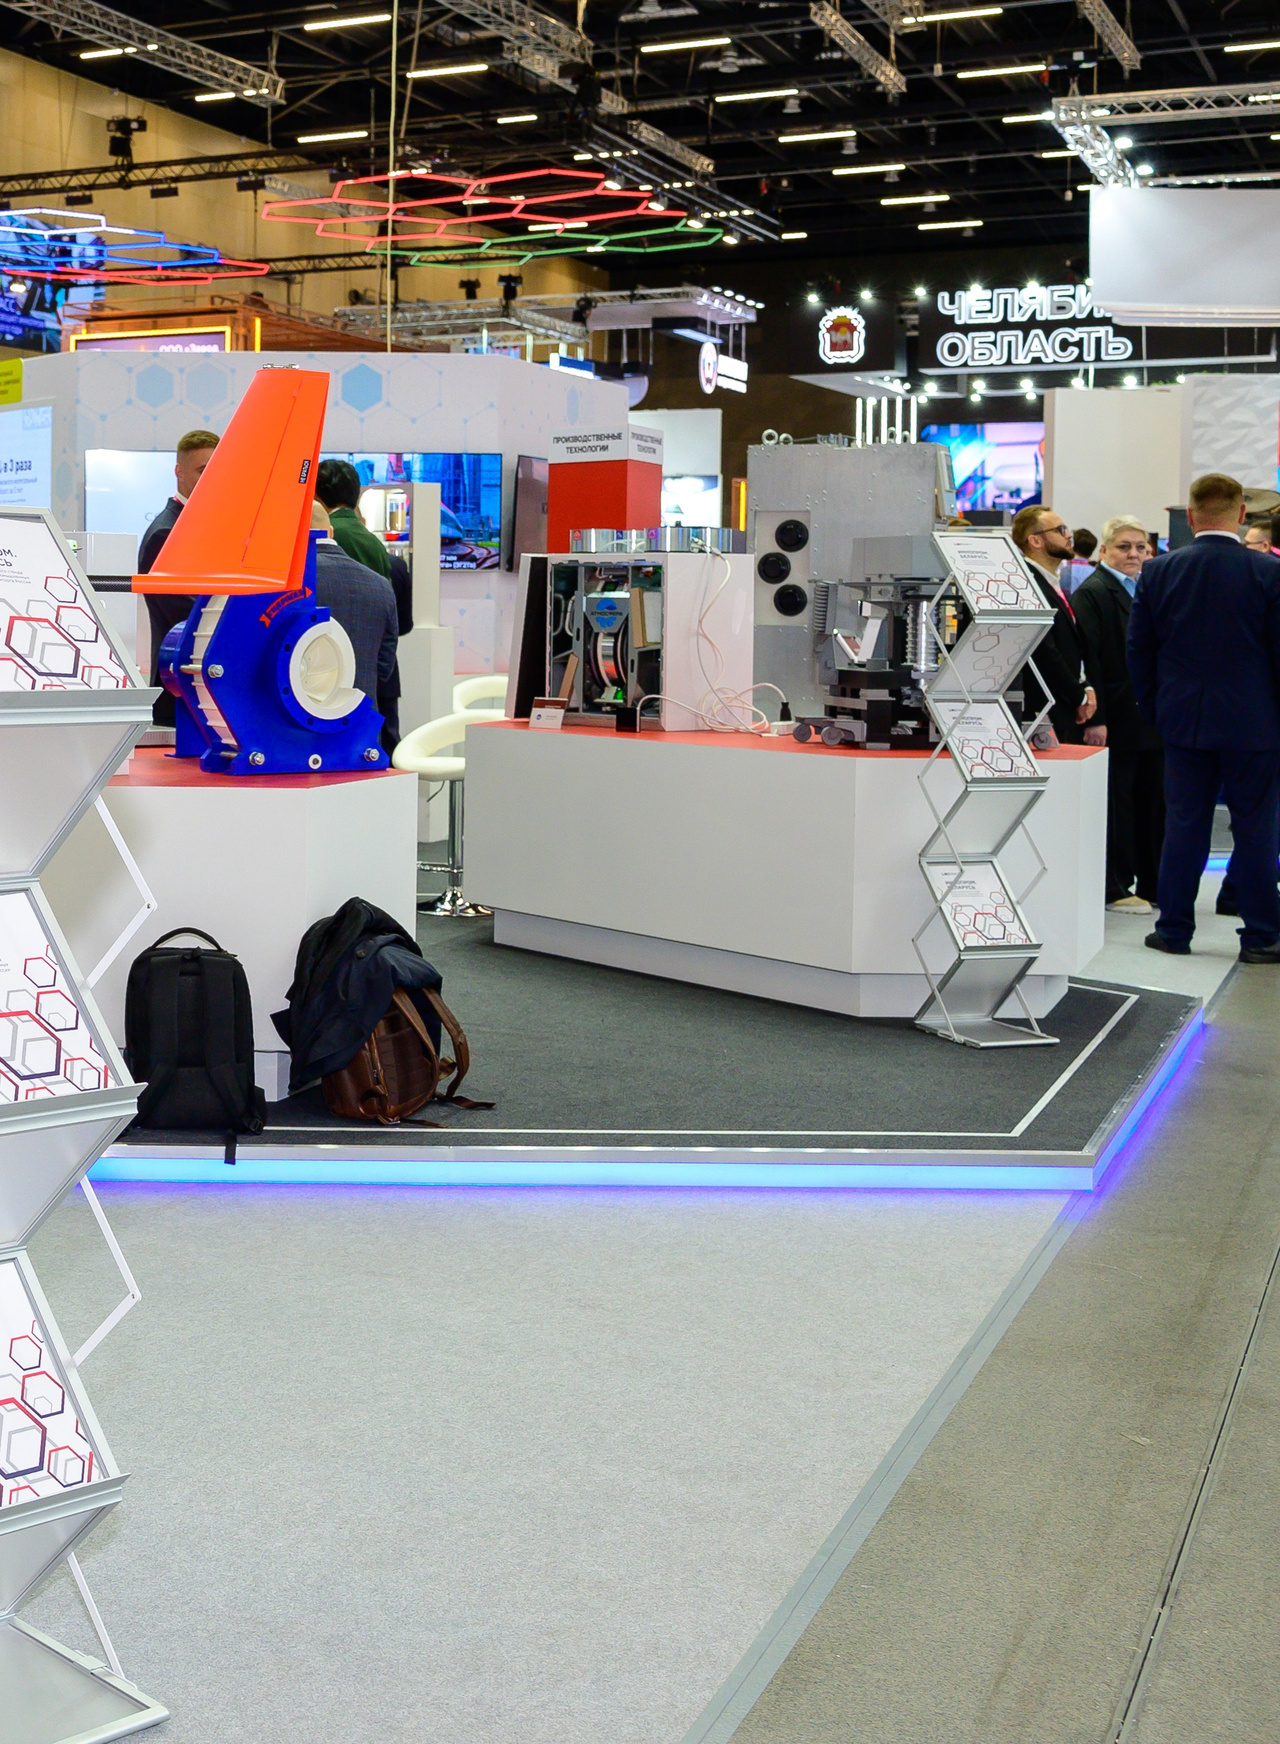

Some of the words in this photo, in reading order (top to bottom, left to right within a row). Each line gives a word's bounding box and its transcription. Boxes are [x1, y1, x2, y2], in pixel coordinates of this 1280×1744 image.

[937, 284, 1113, 324] ЧЕЛЯБИ
[936, 326, 1133, 367] ОБЛАСТЬ
[553, 432, 622, 444] ПРОИЗВОДСТВЕННЫЕ
[566, 445, 609, 454] ТЕХНОЛОГИИ
